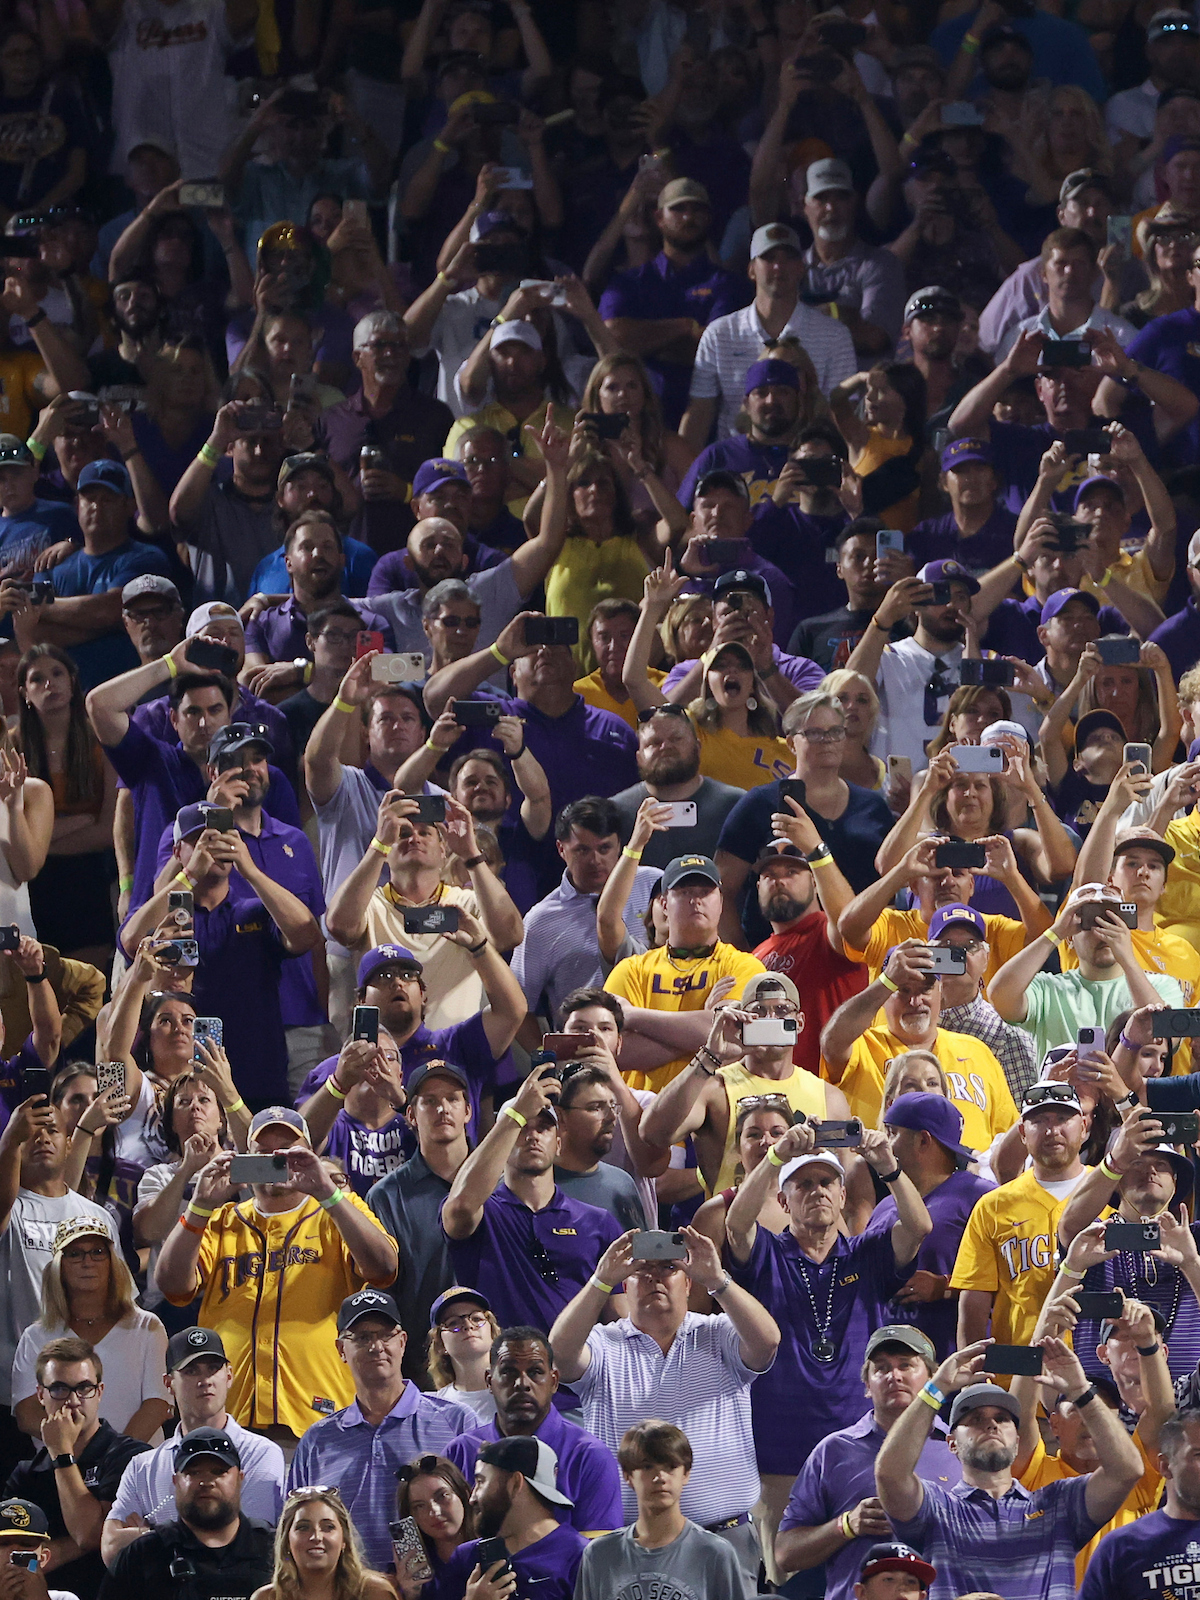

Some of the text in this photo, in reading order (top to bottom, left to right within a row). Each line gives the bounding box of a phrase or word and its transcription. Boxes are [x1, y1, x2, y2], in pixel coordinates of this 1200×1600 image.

[753, 747, 800, 782] LS
[680, 858, 706, 868] LSU
[942, 908, 976, 922] LSU
[652, 970, 709, 996] LSU
[552, 1228, 577, 1236] LSU
[1002, 1235, 1052, 1281] TIG
[219, 1244, 321, 1305] TIGERS
[839, 1273, 860, 1287] LSU
